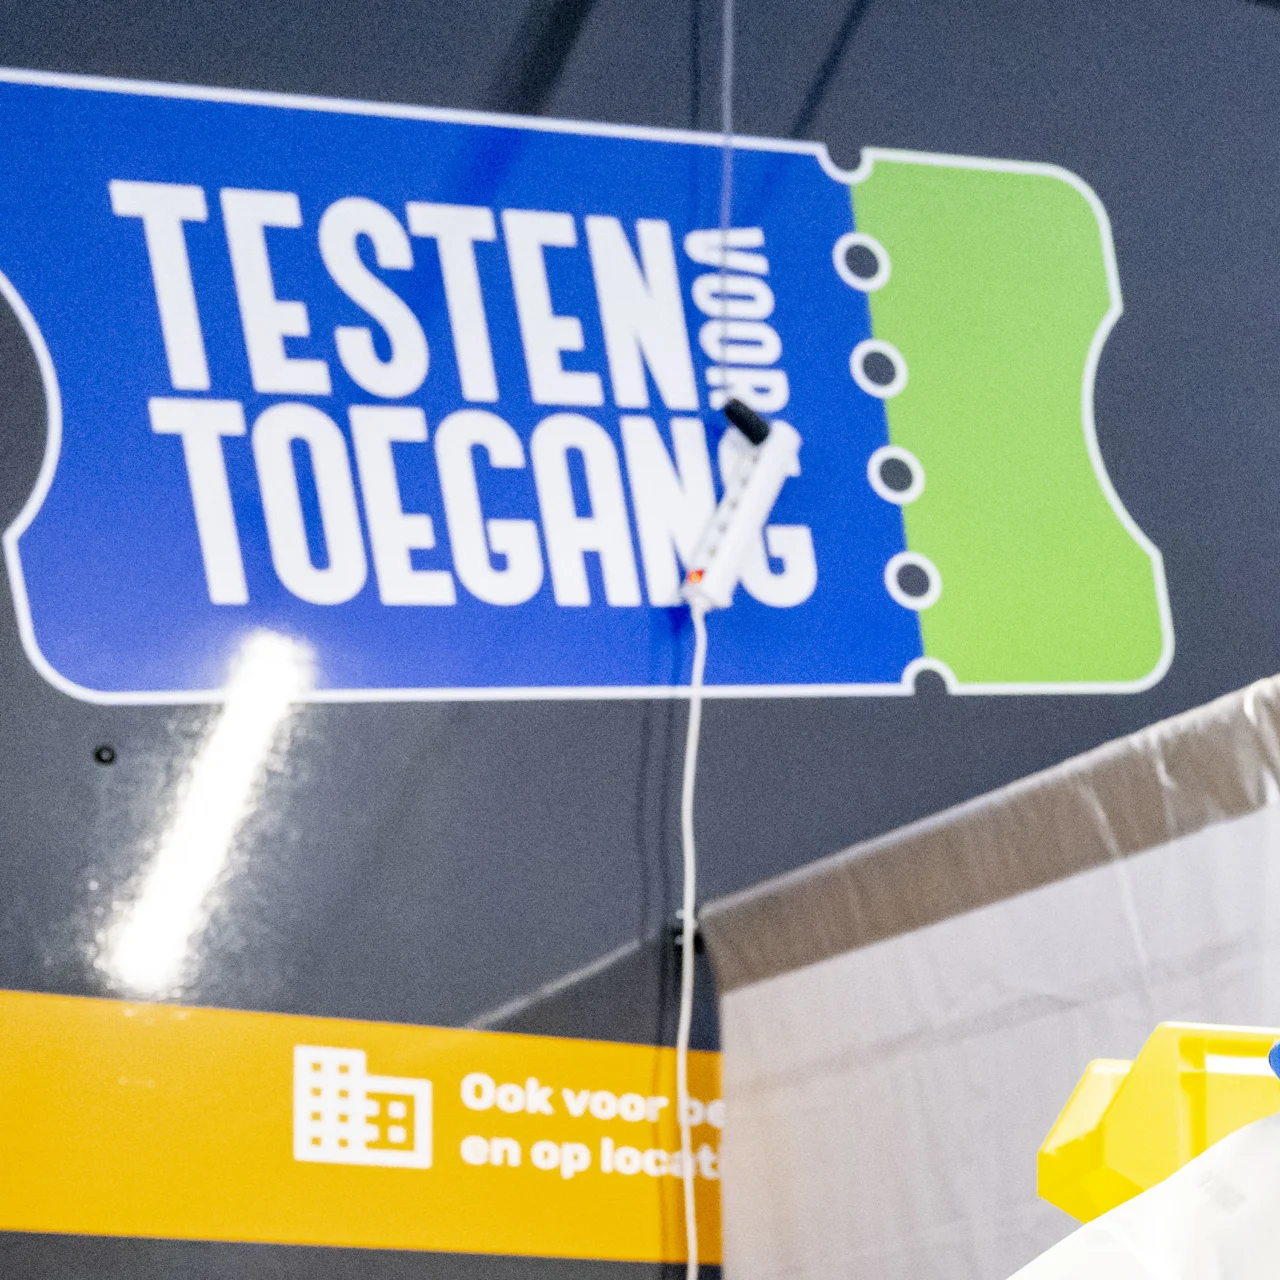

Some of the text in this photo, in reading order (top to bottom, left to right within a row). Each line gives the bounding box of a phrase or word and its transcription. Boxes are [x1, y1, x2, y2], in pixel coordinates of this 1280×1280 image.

[109, 179, 700, 410] TESTEN
[683, 226, 790, 413] VOOR
[460, 1072, 555, 1116] Ook
[561, 1088, 670, 1123] voor
[460, 1135, 722, 1180] en op locat
